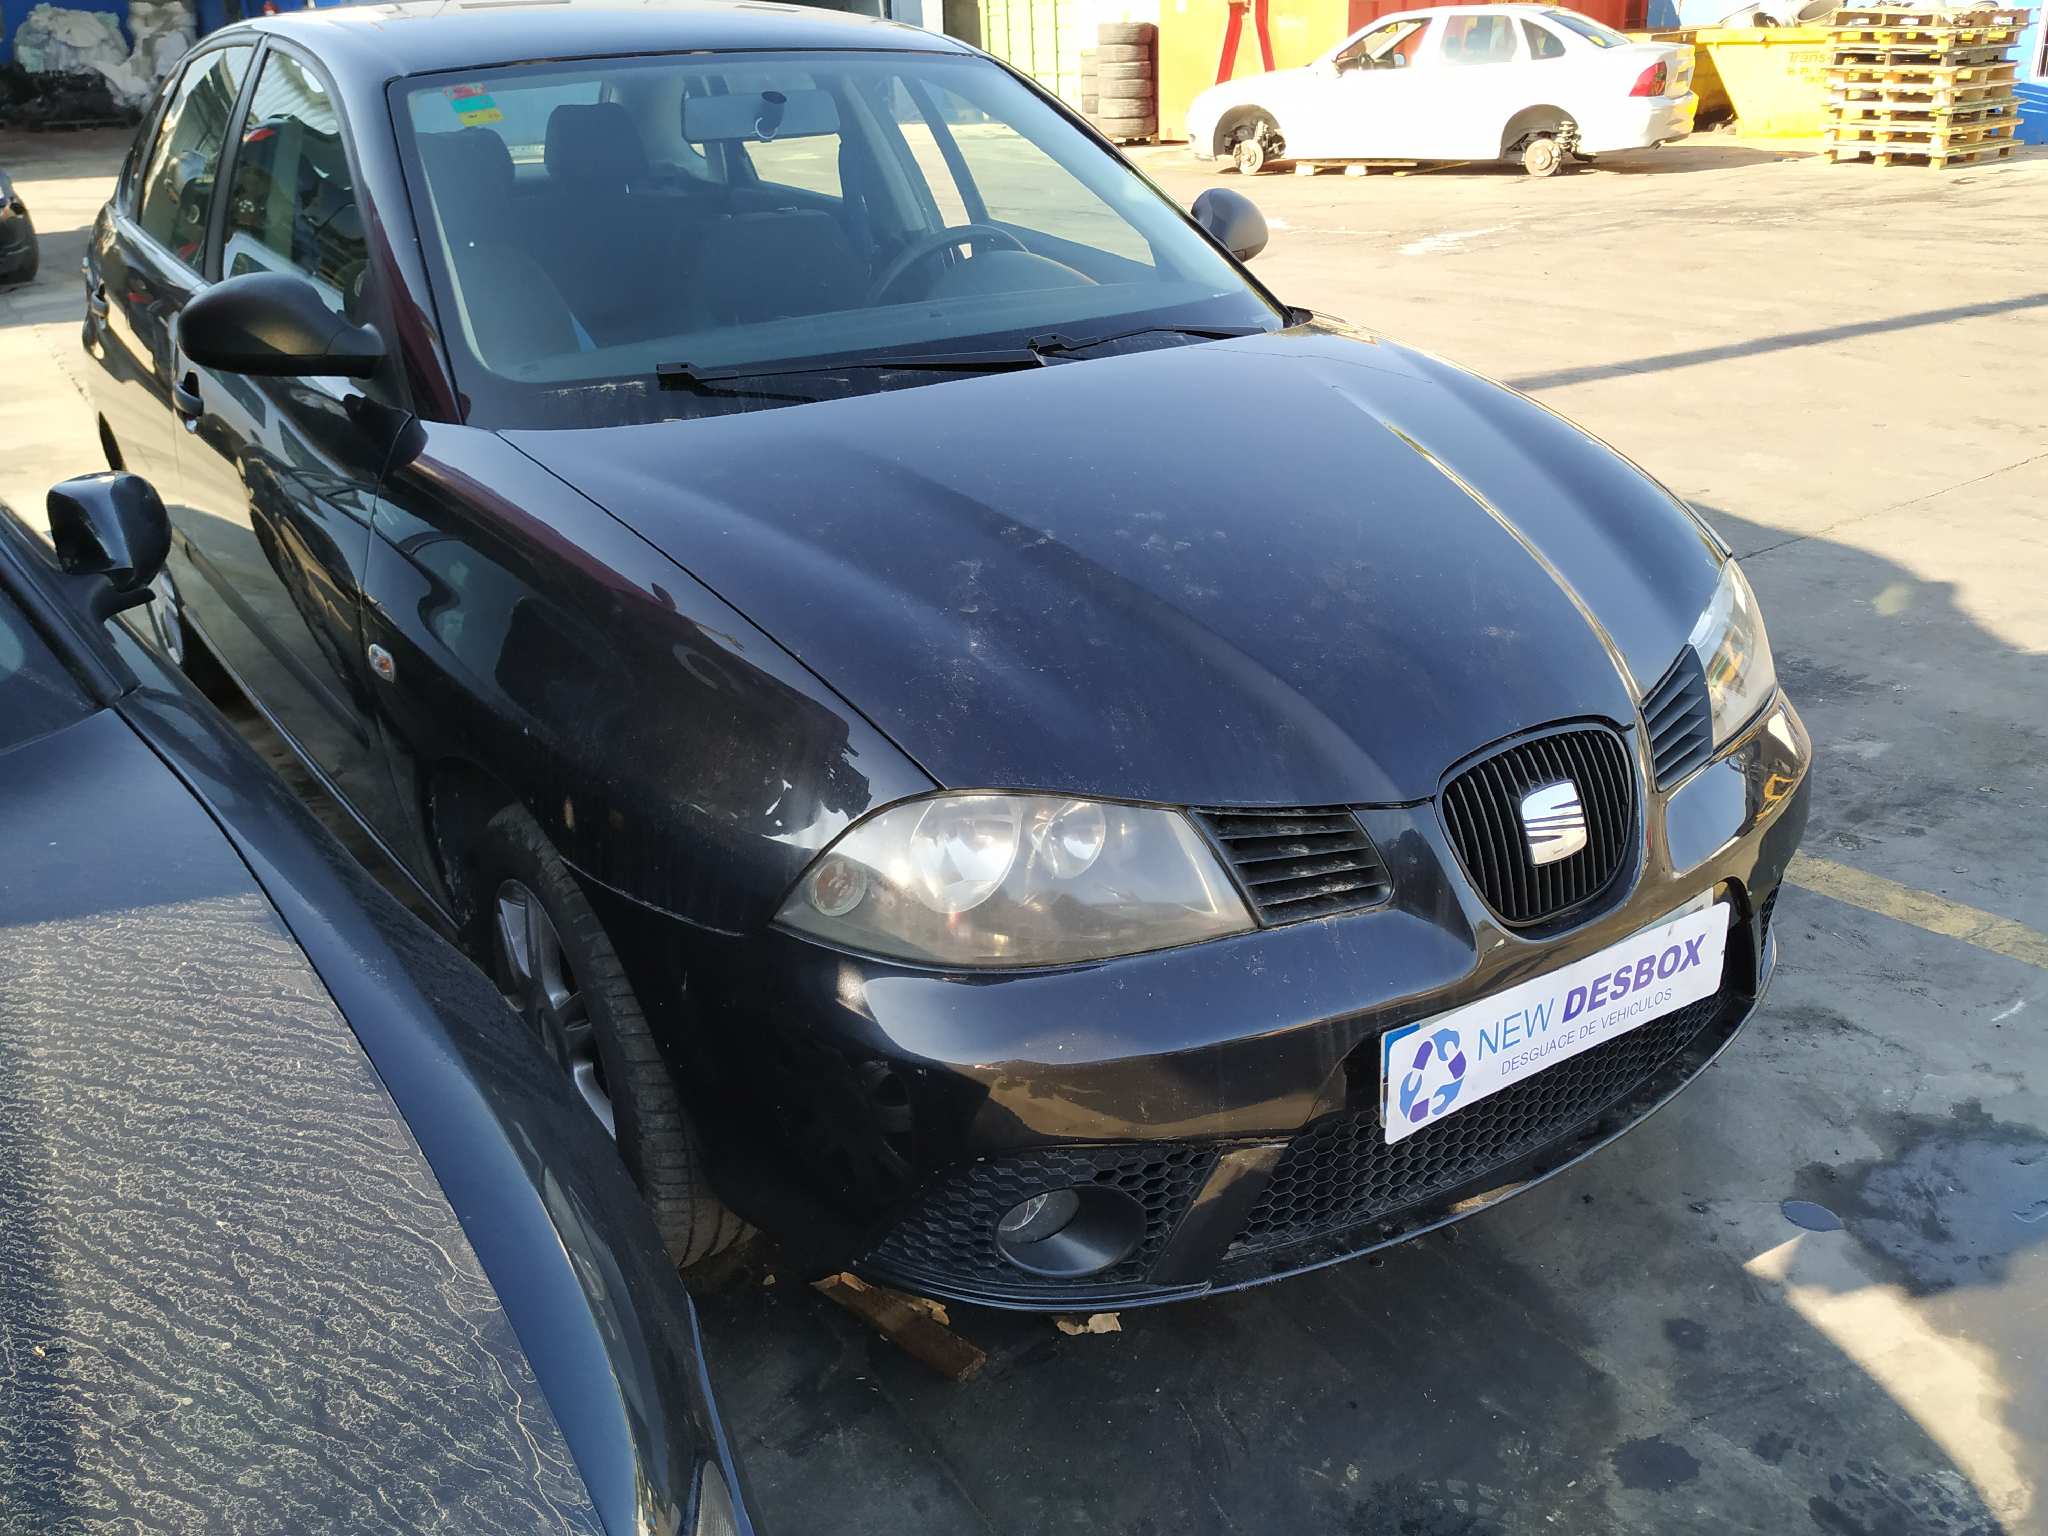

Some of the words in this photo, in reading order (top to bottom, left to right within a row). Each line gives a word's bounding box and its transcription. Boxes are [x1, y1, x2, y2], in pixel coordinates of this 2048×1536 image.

[1478, 998, 1554, 1061] NEW
[1561, 933, 1706, 1024] DESBOX
[1501, 1030, 1575, 1076] DESGUACE
[1579, 1021, 1598, 1039] DE
[1601, 988, 1672, 1029] VEHICULOS
